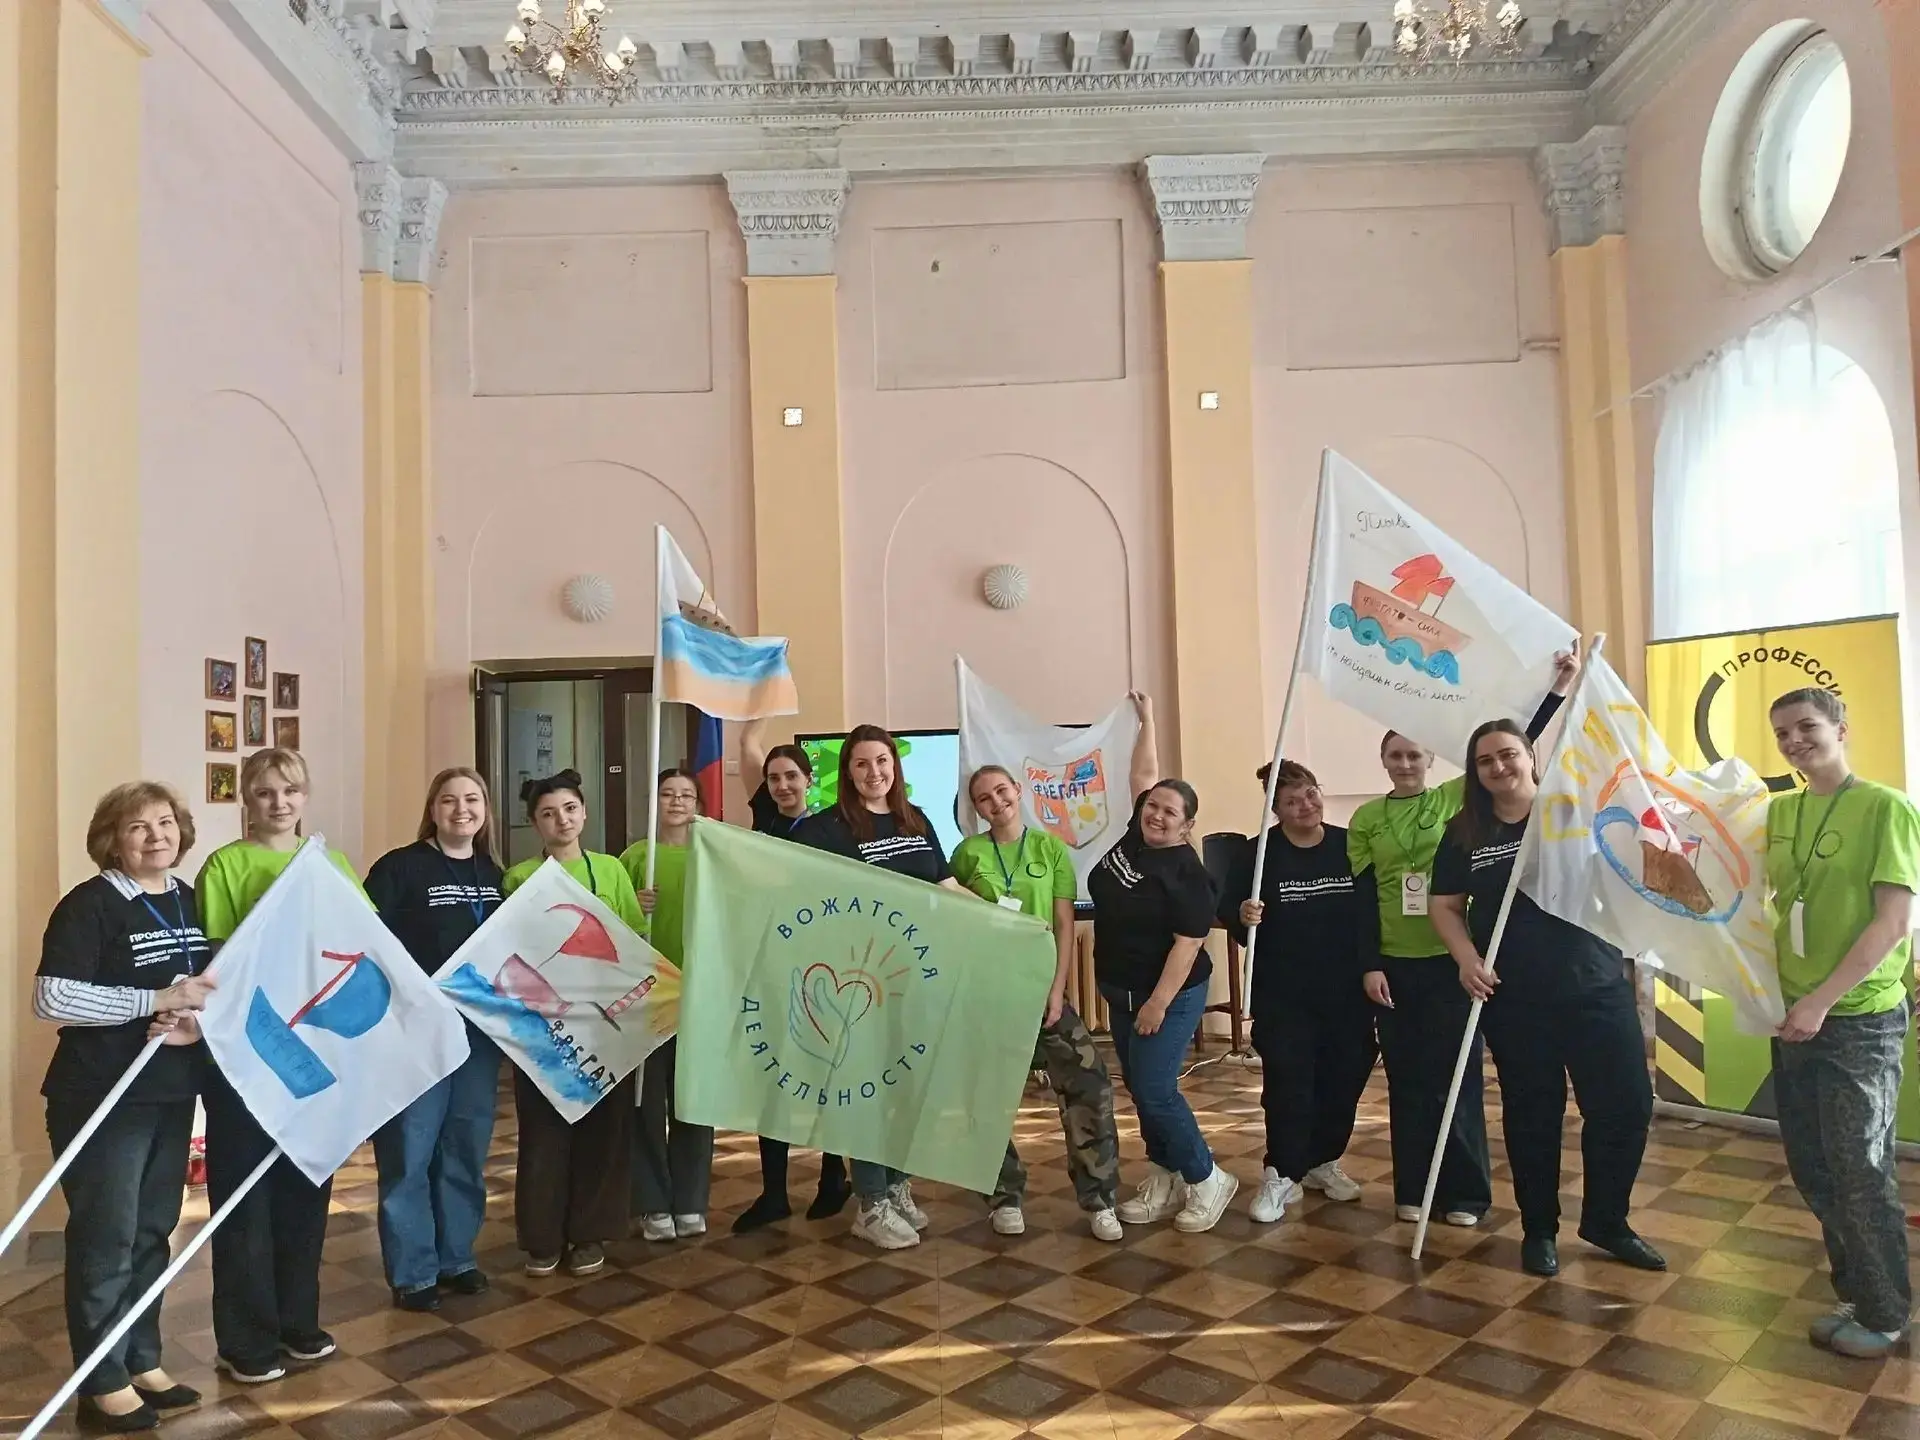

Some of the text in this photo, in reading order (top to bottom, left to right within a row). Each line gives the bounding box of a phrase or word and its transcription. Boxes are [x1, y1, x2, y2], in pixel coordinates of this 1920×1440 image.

[1721, 646, 1847, 712] ПРОФЕССИ
[1033, 781, 1089, 800] ФРЕГАТ
[1279, 875, 1353, 889] ПРОФЕССИОНАЛЫ
[129, 927, 204, 943] ПРОФЕСИНАЛЫ
[777, 897, 938, 979] ВОЖАТСКАЯ
[741, 996, 926, 1106] ДЕЯТЕЛЬНОСТЬ
